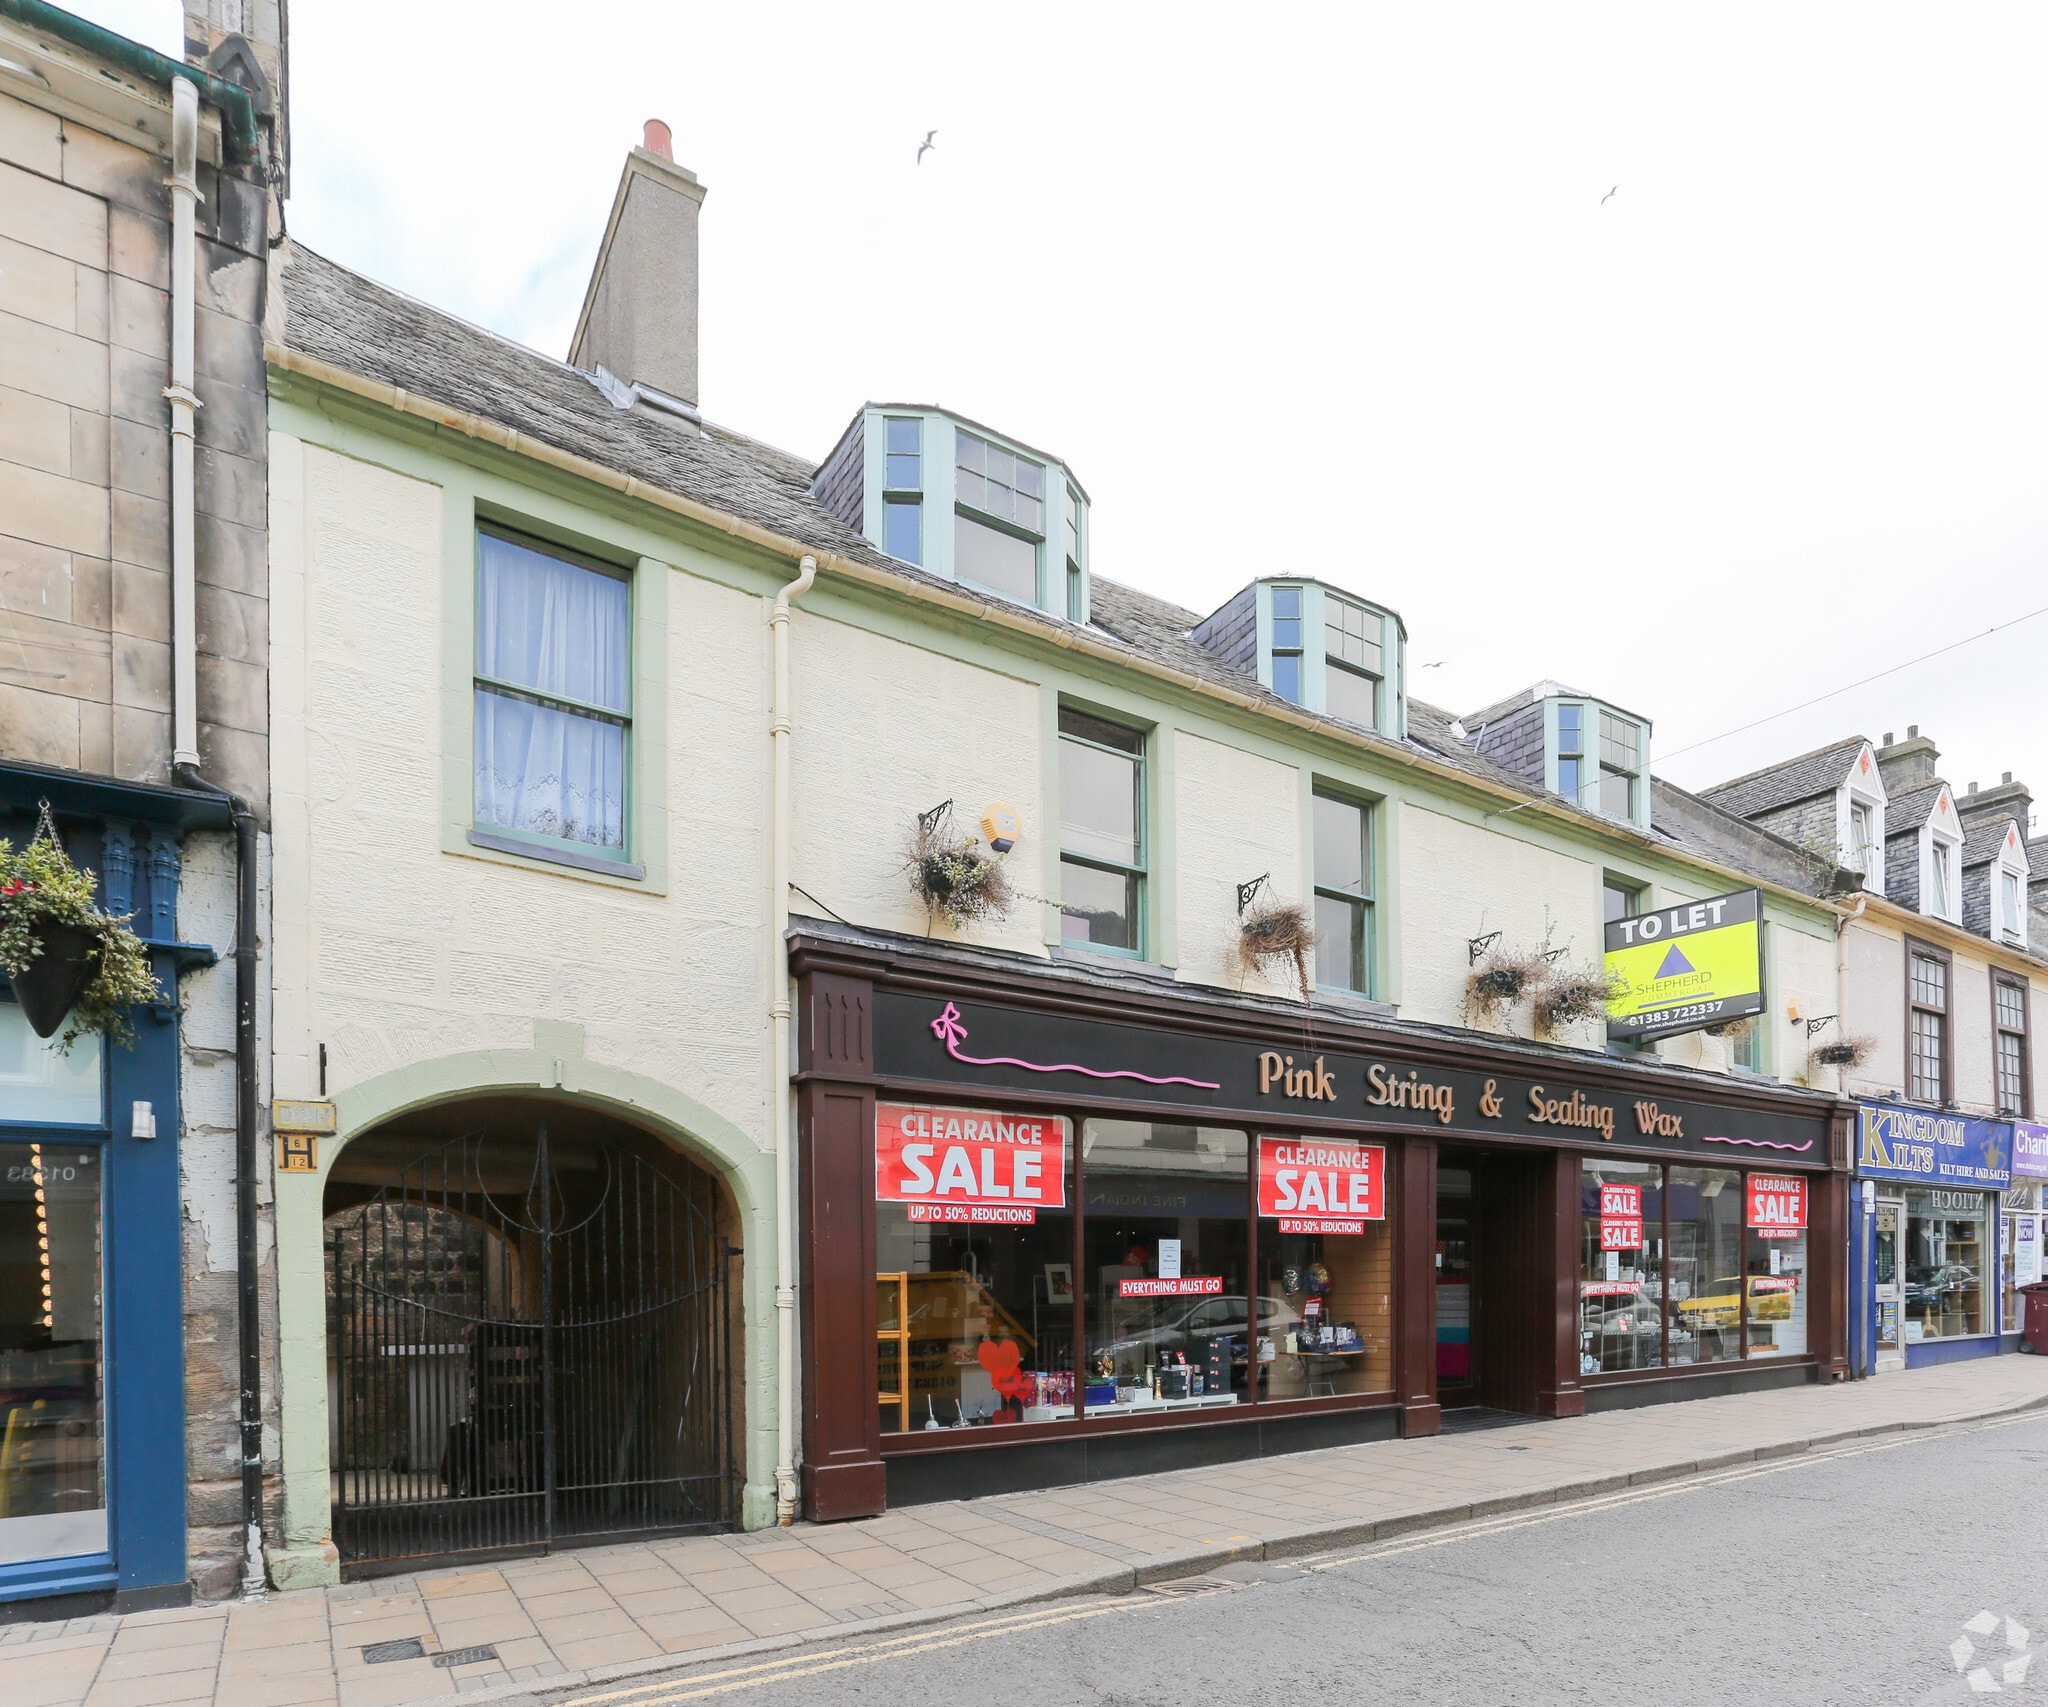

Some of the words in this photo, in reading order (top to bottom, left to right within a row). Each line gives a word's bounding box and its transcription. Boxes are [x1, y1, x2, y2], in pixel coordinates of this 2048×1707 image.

[1620, 915, 1663, 944] TO
[1670, 899, 1727, 934] LET
[1636, 971, 1713, 996] SHEPHERD
[1641, 985, 1710, 1003] COMMERCIAL
[1629, 1010, 1670, 1027] 01383
[1672, 1000, 1724, 1019] 722337
[1646, 1015, 1706, 1030] www.shepherd.co.uk
[1258, 1051, 1337, 1101] Pink
[1366, 1064, 1455, 1124] String
[1478, 1078, 1504, 1118] &
[1528, 1085, 1615, 1140] Sealing
[1633, 1100, 1684, 1138] Wax
[901, 1114, 1042, 1145] CLEARANCE
[294, 1139, 300, 1148] 6
[293, 1158, 305, 1167] 12
[1275, 1146, 1369, 1169] CLEARANCE
[901, 1143, 1042, 1198] SALE
[1939, 1163, 1956, 1176] KILT
[1956, 1165, 1974, 1178] HIRE
[1974, 1167, 1989, 1179] AND
[1989, 1168, 2010, 1182] SALES
[1275, 1169, 1369, 1213] SALE
[1755, 1178, 1800, 1193] CLEARANCE
[1603, 1194, 1638, 1214] SALE
[1754, 1194, 1800, 1224] SALE
[911, 1206, 924, 1219] UP
[928, 1206, 942, 1220] TO
[945, 1207, 968, 1220] 50%
[972, 1207, 1032, 1222] REDUCTIONS
[1281, 1220, 1290, 1231] UP
[1292, 1221, 1301, 1231] TO
[1304, 1221, 1319, 1232] 50%
[1321, 1221, 1361, 1232] REDUCTIONS
[1603, 1228, 1639, 1247] SALE
[1122, 1281, 1176, 1293] EVERYTHING
[1180, 1280, 1203, 1291] MUST
[1206, 1279, 1220, 1291] GO
[1586, 1284, 1616, 1294] EVERYTHING
[1617, 1284, 1630, 1292] MUST
[1631, 1283, 1639, 1292] GO
